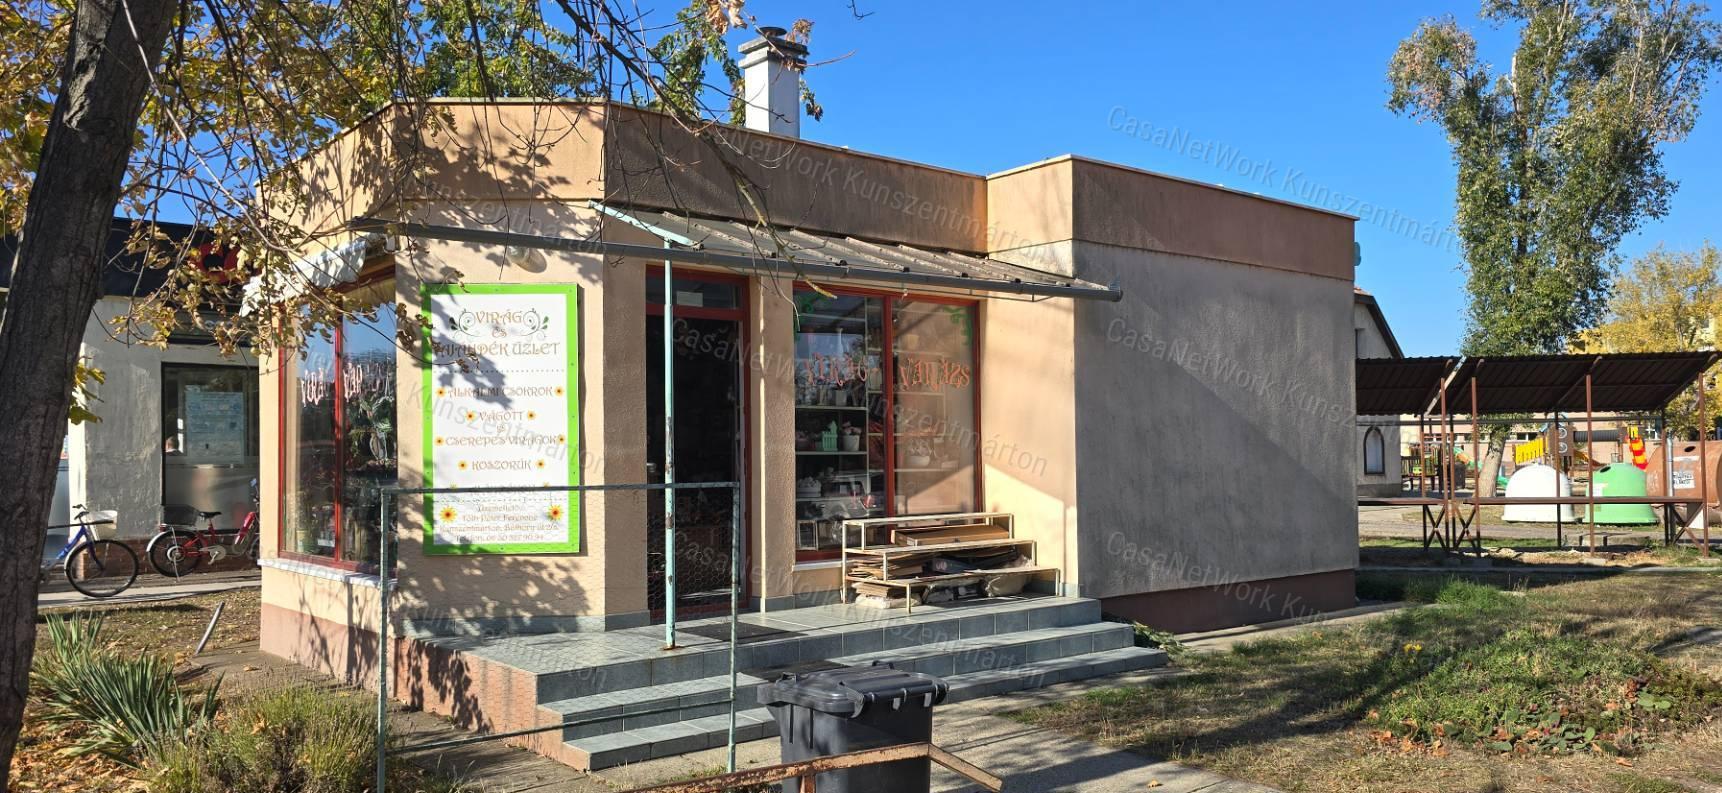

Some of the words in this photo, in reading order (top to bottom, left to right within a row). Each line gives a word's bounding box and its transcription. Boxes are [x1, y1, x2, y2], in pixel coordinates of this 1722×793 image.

[475, 309, 522, 325] VIRÁG
[513, 341, 560, 355] ÜZLET
[448, 387, 500, 397] ALKALMI
[502, 385, 553, 397] CSOKROK
[479, 409, 523, 421] VÁGOTT
[446, 434, 506, 447] CSEREPES
[471, 459, 532, 471] KOSZORÚK
